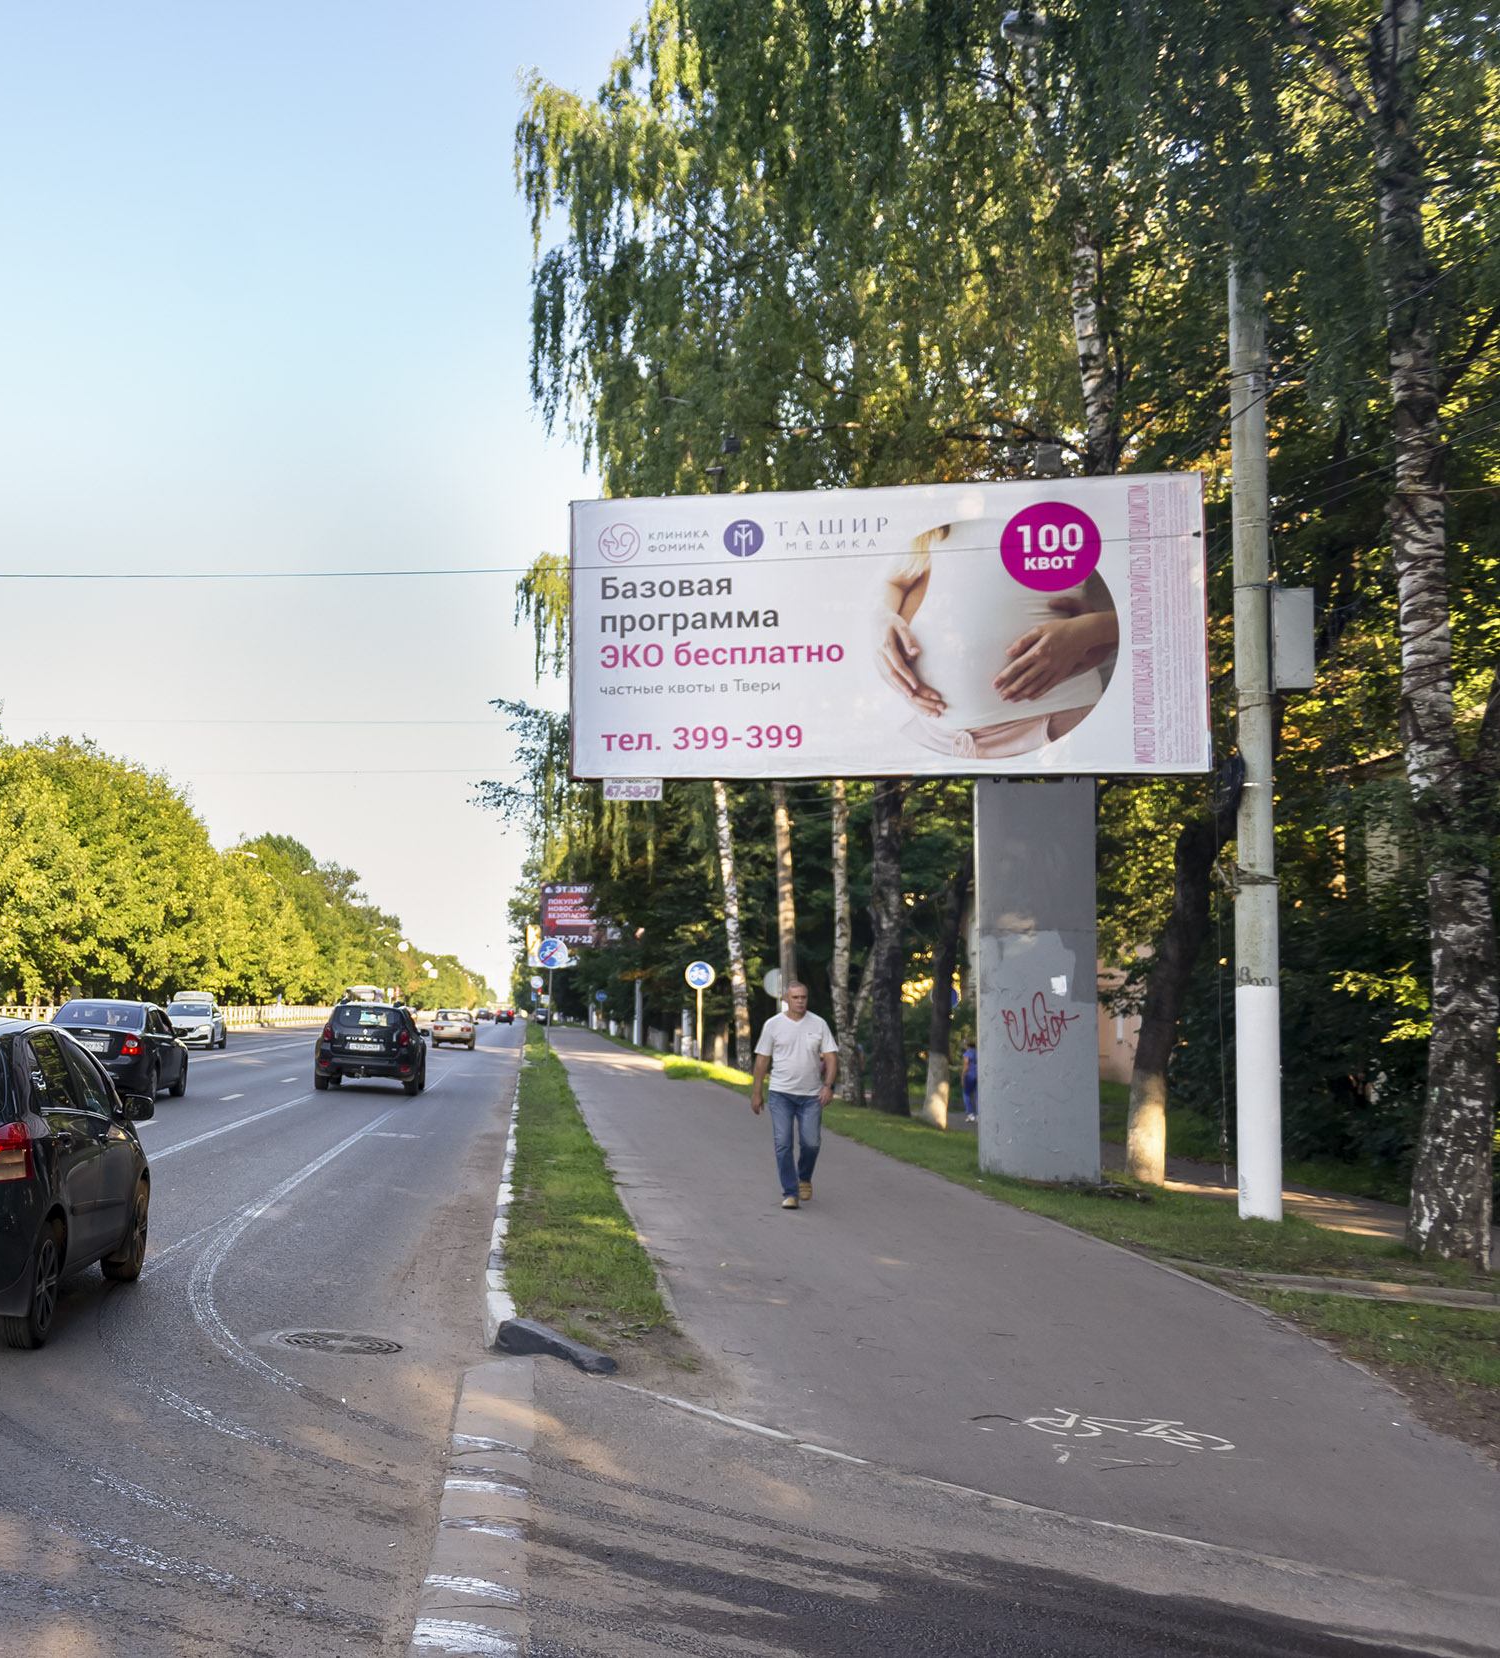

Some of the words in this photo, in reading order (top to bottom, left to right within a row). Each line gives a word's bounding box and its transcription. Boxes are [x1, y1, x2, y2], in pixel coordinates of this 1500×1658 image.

[648, 529, 710, 541] КЛИНИКА
[774, 516, 889, 537] ТАШИР
[648, 542, 705, 553] ФОМИНА
[785, 538, 877, 551] МЕДИКА
[1016, 523, 1084, 554] 100
[1024, 555, 1076, 571] КВОТ
[601, 576, 732, 600] Базовая
[600, 608, 779, 638] программа
[600, 643, 664, 669] ЭКО
[674, 641, 845, 667] бесплатно
[600, 683, 664, 695] частные
[668, 683, 715, 694] квоты
[720, 682, 728, 692] в
[733, 679, 781, 694] Твери
[601, 733, 661, 751] тел.
[672, 725, 803, 750] 399-399
